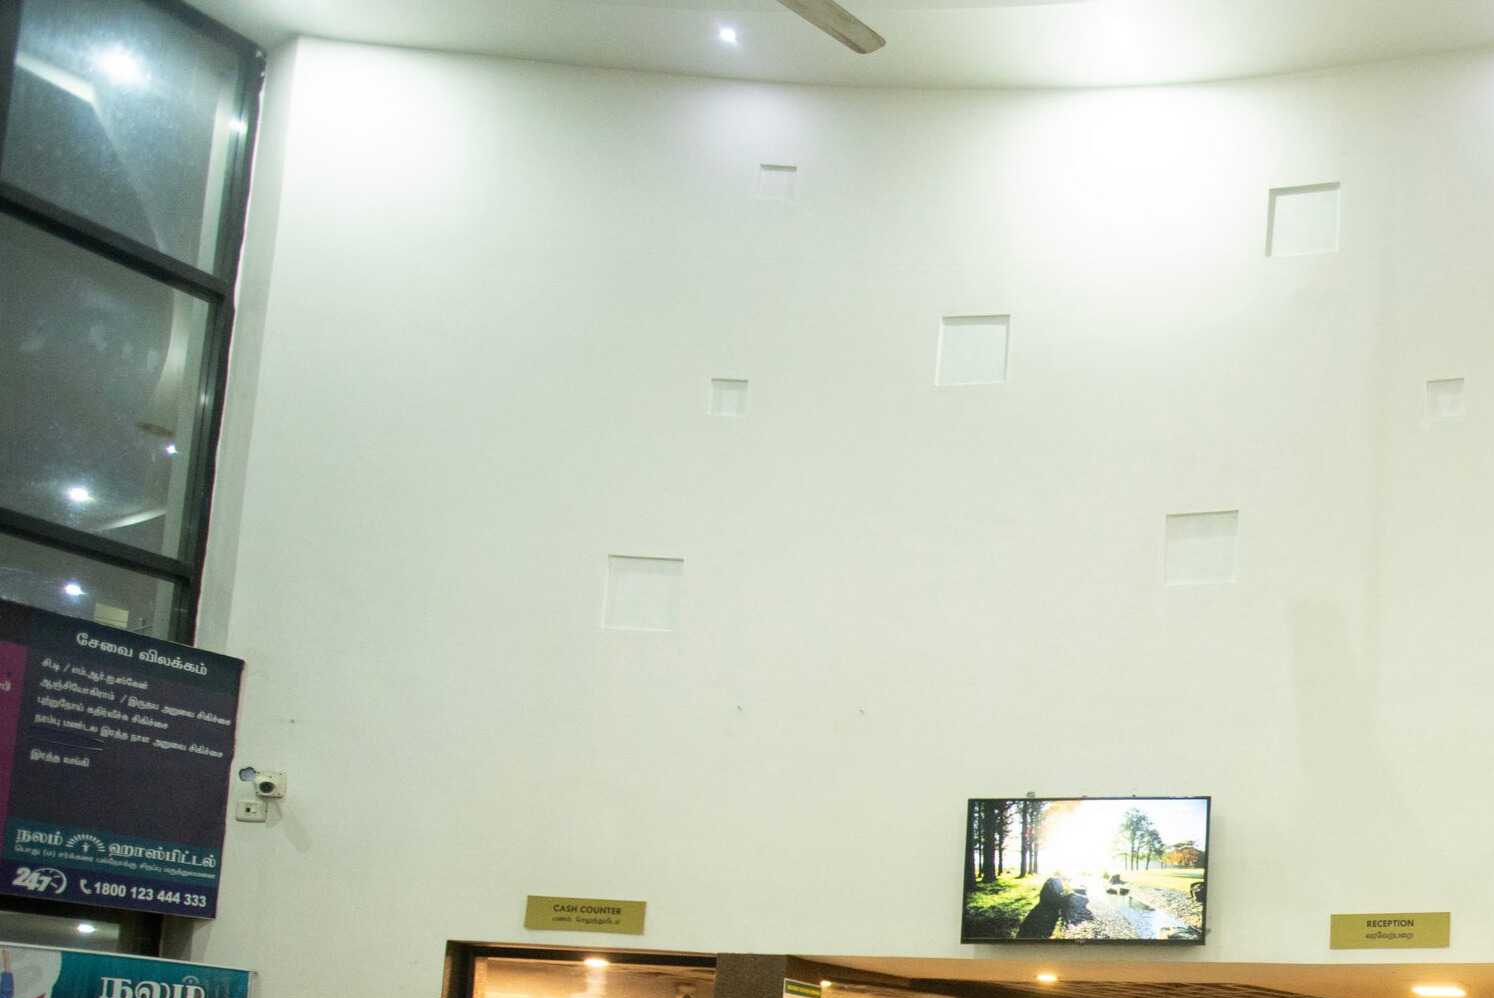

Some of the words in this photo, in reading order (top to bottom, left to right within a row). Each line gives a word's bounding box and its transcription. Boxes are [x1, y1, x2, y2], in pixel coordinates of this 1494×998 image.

[76, 632, 133, 658] சேவை
[94, 882, 127, 898] 1800
[130, 887, 154, 901] 123
[156, 890, 181, 904] 444
[184, 893, 207, 908] 333
[553, 904, 578, 913] CASH
[580, 906, 622, 915] COUNTER
[1366, 920, 1414, 928] RECEPTION
